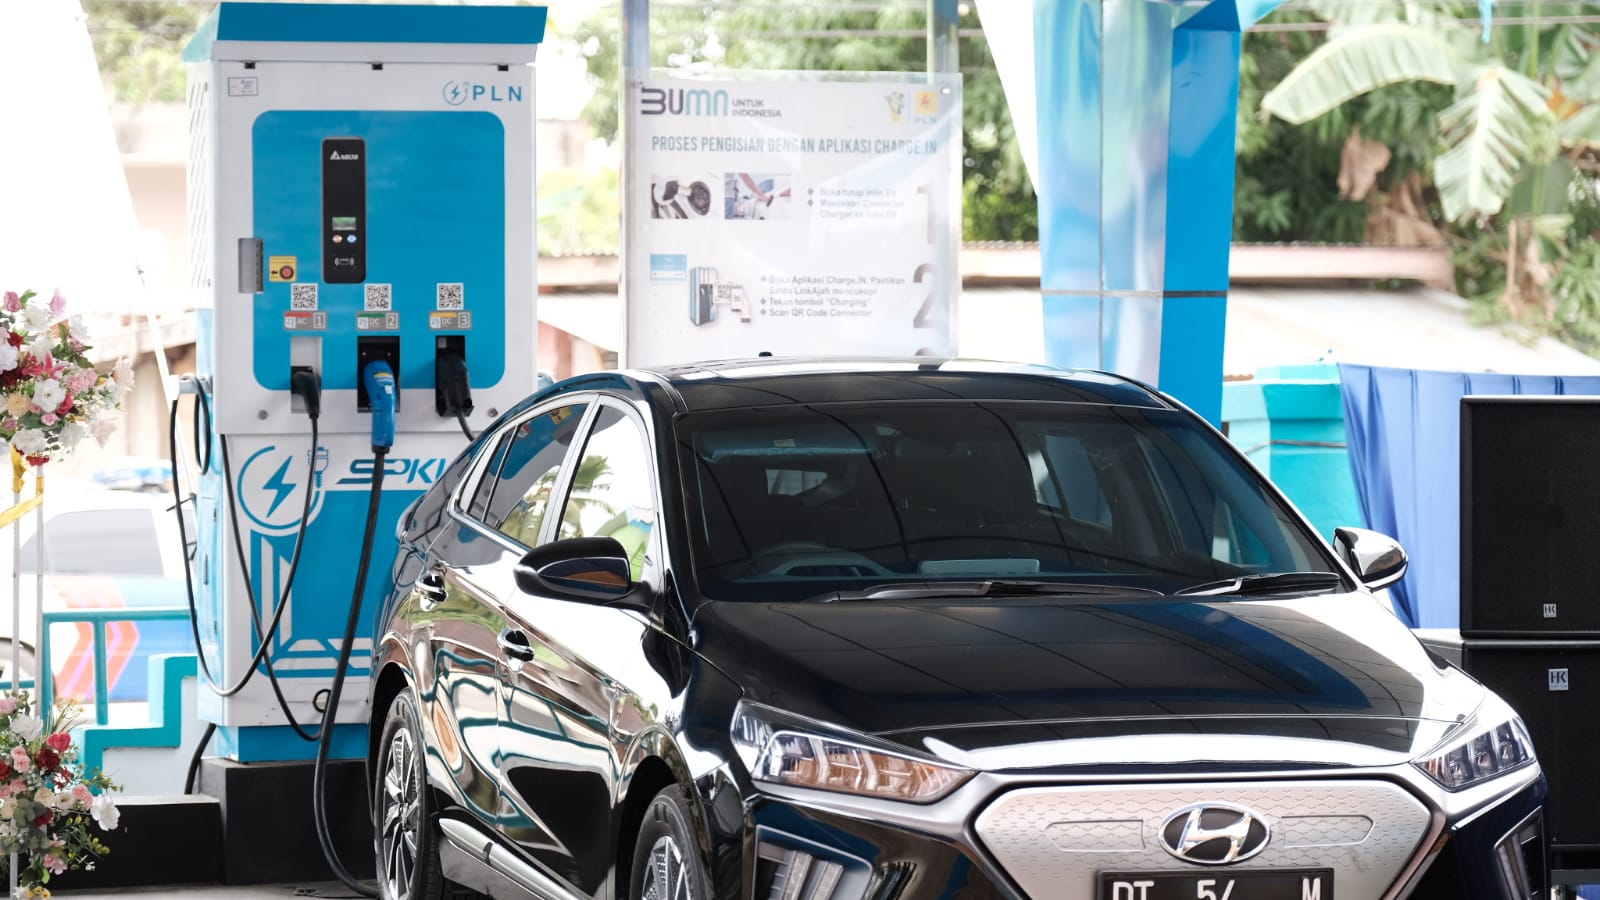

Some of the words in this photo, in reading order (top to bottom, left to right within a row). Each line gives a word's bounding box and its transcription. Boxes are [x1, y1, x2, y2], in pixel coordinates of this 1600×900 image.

[472, 84, 523, 103] PLN
[731, 98, 765, 108] UNTUK
[731, 108, 782, 118] INDONESIA
[651, 135, 697, 152] PROSES
[701, 136, 765, 153] PENGISIAN
[768, 137, 815, 153] DENGAN
[818, 138, 872, 153] APLIKASI
[915, 184, 937, 245] 1
[792, 275, 825, 286] Aplikasi
[870, 276, 905, 285] Pastikan
[794, 286, 831, 297] LinkAjah
[913, 263, 937, 329] 2
[794, 297, 824, 306] tombol
[769, 307, 790, 317] Scan
[791, 308, 805, 318] QR
[806, 308, 828, 318] Code
[830, 308, 872, 318] Connector
[1551, 670, 1567, 685] HK
